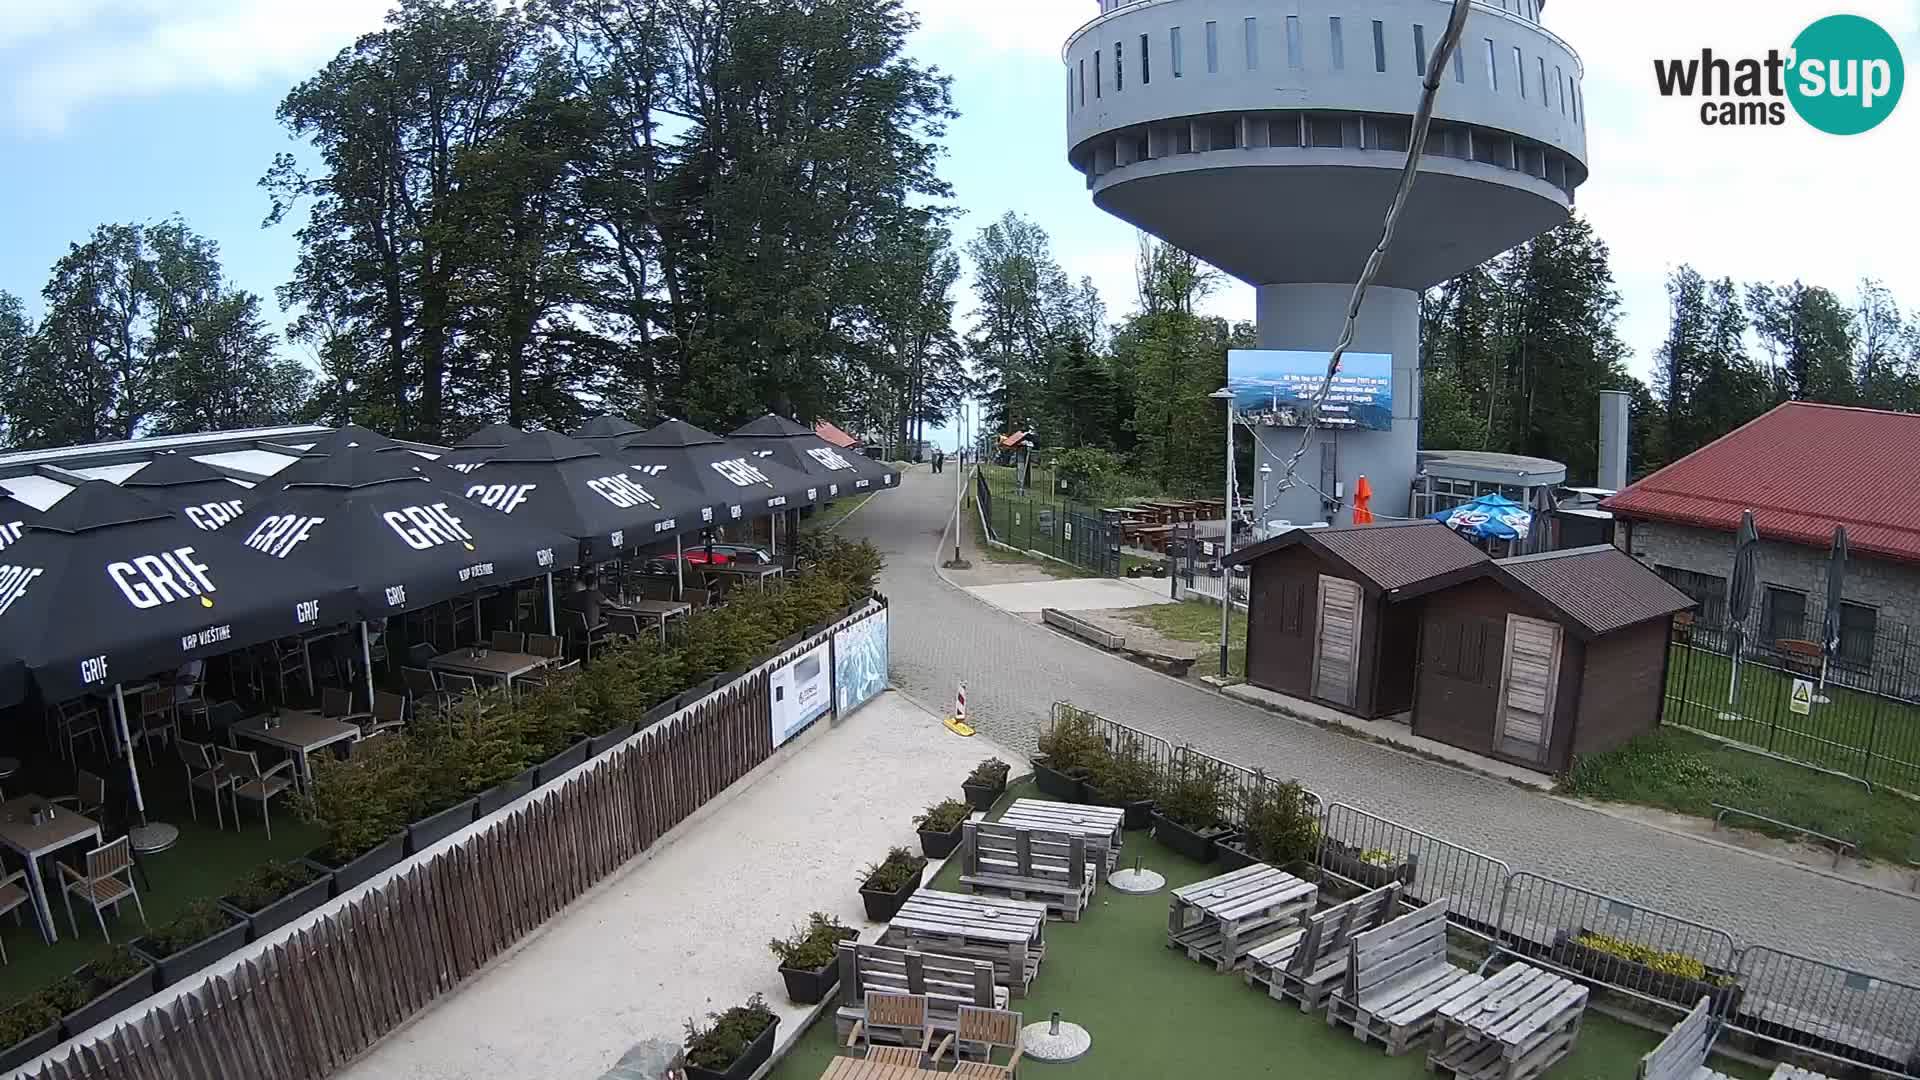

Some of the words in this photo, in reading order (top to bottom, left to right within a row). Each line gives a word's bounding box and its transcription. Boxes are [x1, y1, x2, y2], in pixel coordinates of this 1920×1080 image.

[711, 457, 769, 487] GRIF
[806, 446, 853, 471] GRIF
[586, 472, 656, 508] GRIF
[244, 514, 326, 559] GRIF
[383, 502, 473, 550] GRIF
[0, 564, 44, 616] RIF
[107, 546, 217, 609] GRIF
[385, 584, 407, 608] GRIF
[296, 599, 320, 625] GRIF
[181, 635, 198, 651] KAP
[81, 655, 109, 685] GRIF
